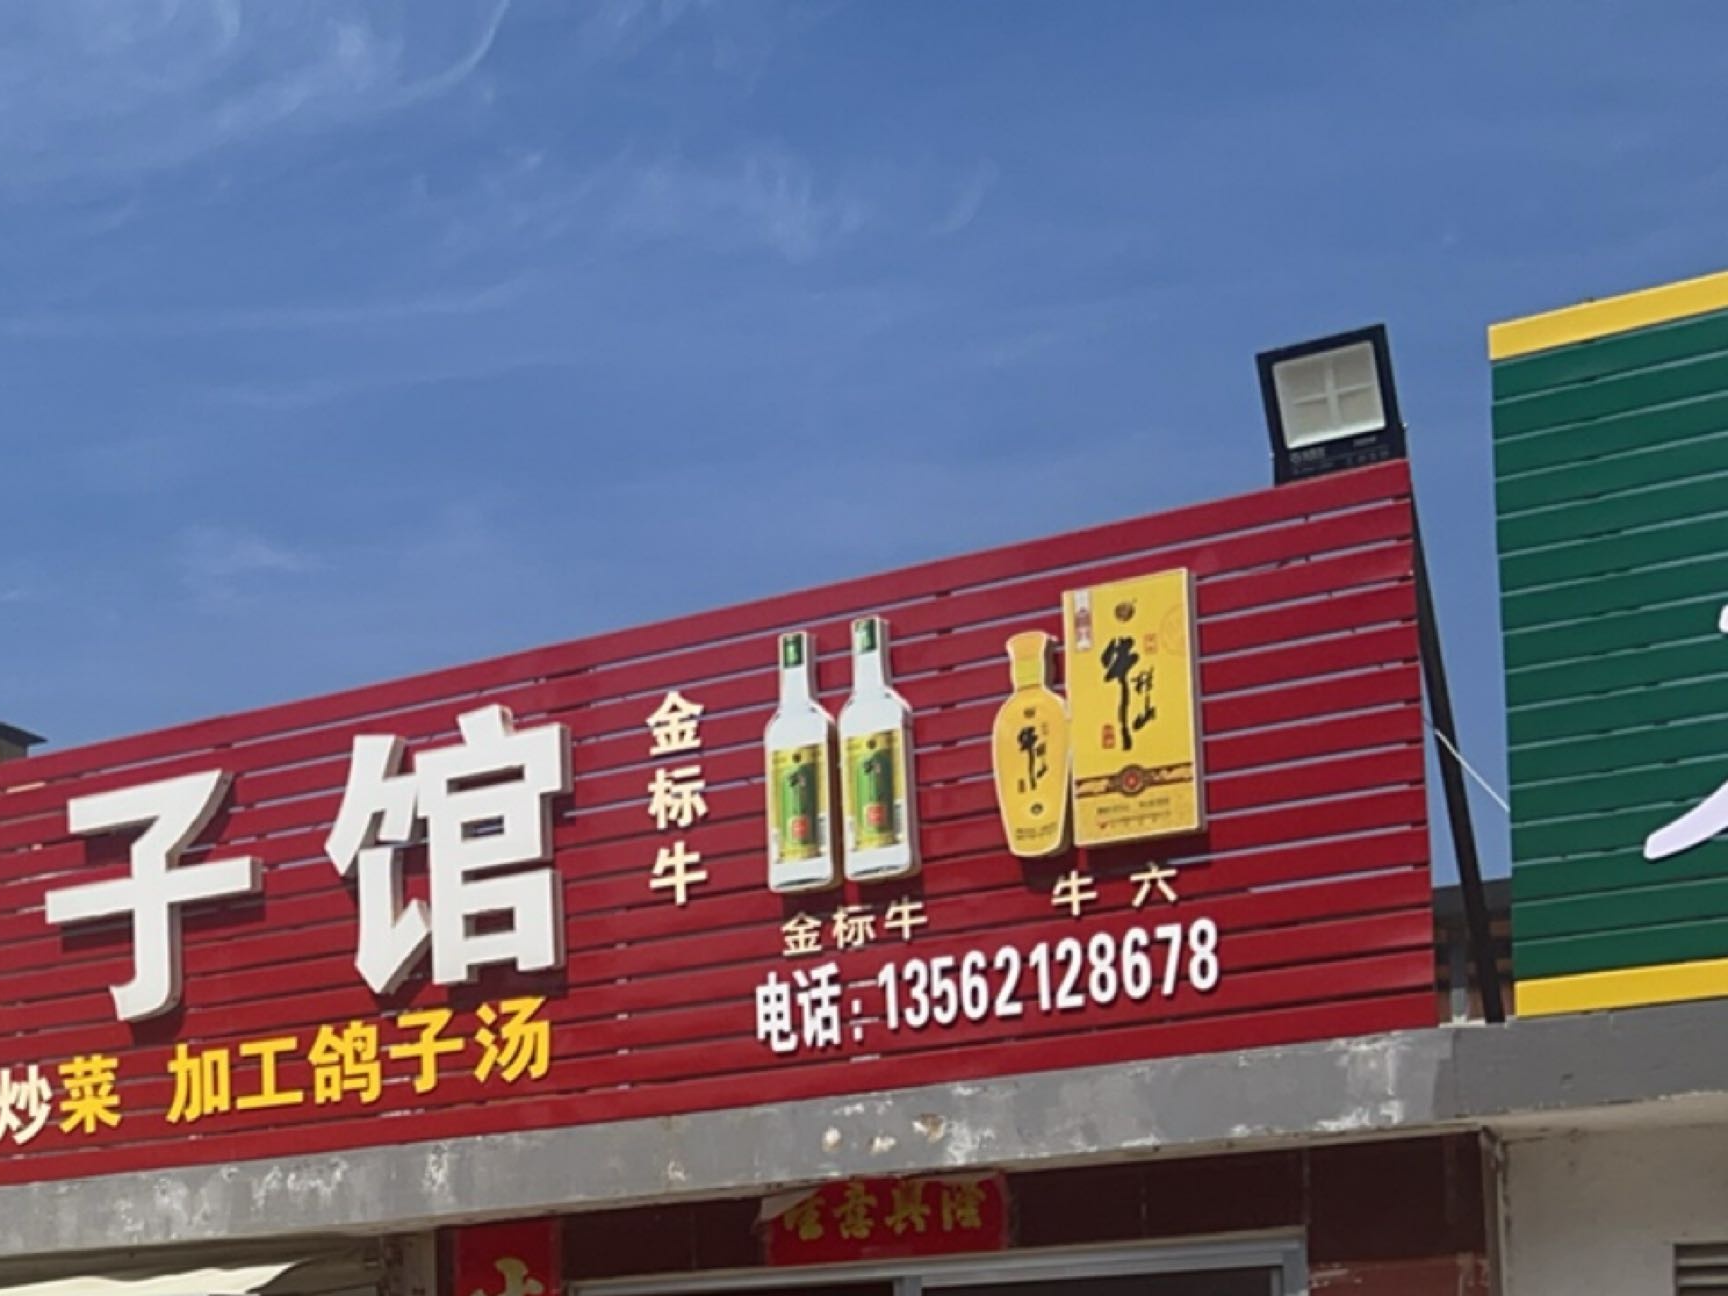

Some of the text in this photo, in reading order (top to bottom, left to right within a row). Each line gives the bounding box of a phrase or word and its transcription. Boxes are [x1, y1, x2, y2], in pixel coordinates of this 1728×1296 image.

[646, 690, 707, 907] 金标牛
[781, 897, 929, 956] 金标牛
[166, 996, 551, 1123] 加工鸽子汤
